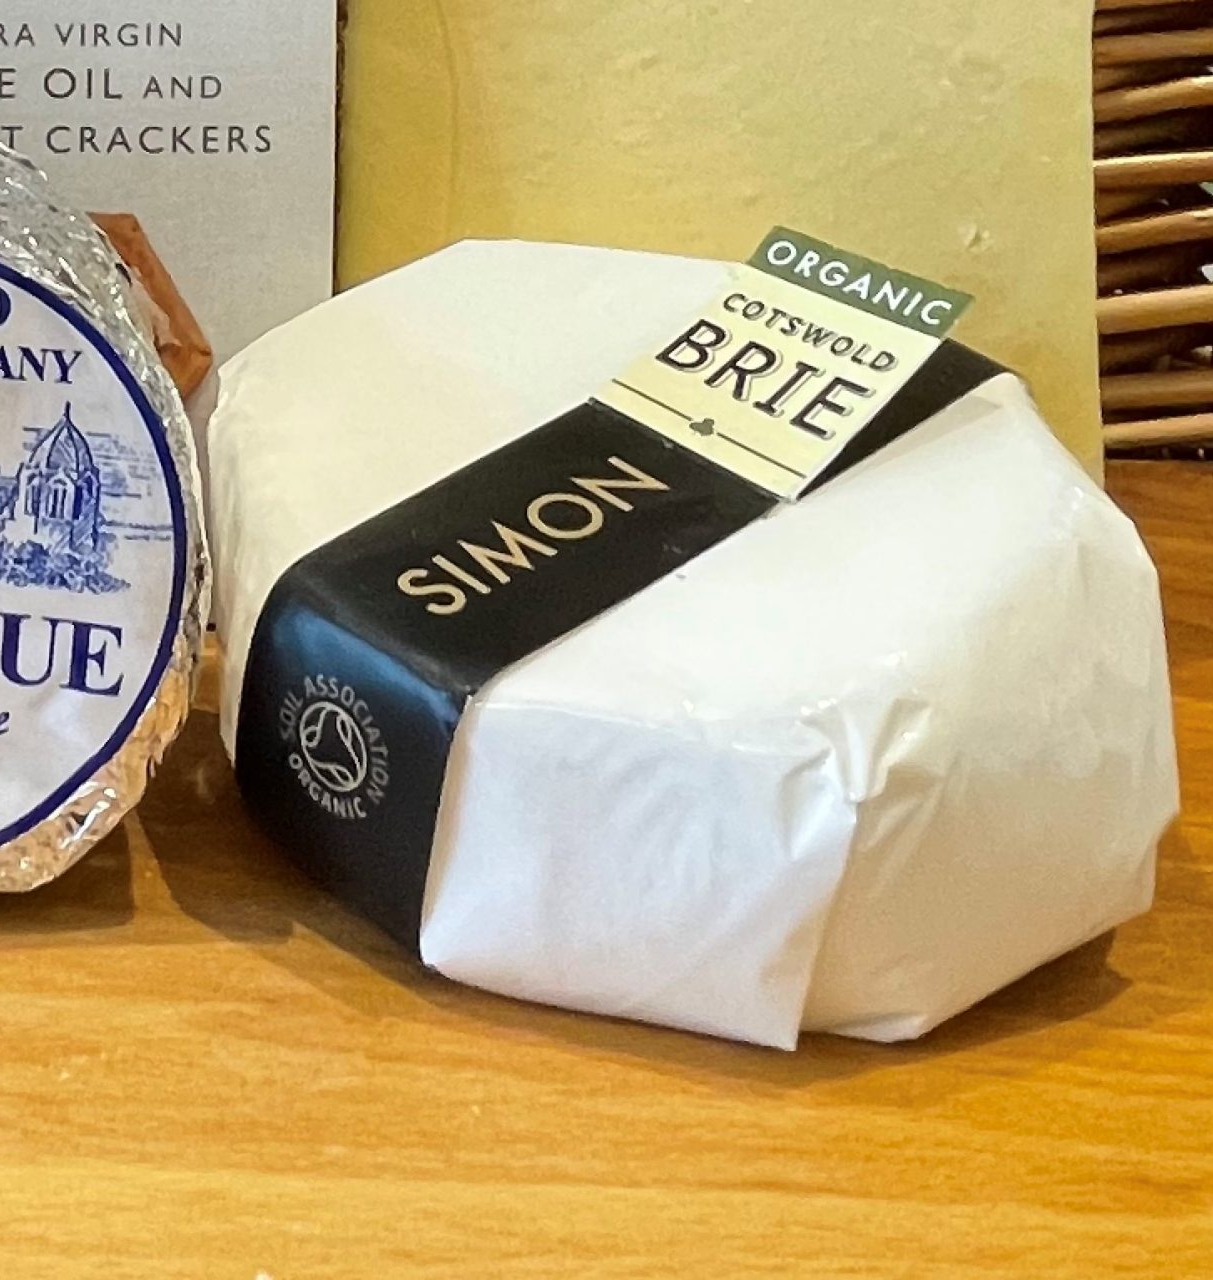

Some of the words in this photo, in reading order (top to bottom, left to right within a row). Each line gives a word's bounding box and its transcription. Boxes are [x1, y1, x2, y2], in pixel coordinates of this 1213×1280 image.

[55, 22, 182, 47] VIRGIN
[43, 67, 123, 100] OIL
[143, 75, 222, 100] AND
[46, 125, 272, 155] CRACKERS
[765, 238, 954, 327] ORGANIC
[723, 292, 900, 374] COTSWOLD
[655, 318, 872, 441] BRIE
[396, 455, 671, 616] SIMON
[279, 691, 304, 741] SOIL
[304, 673, 388, 804] ASSOCIATION
[288, 752, 367, 819] ORGANIC
